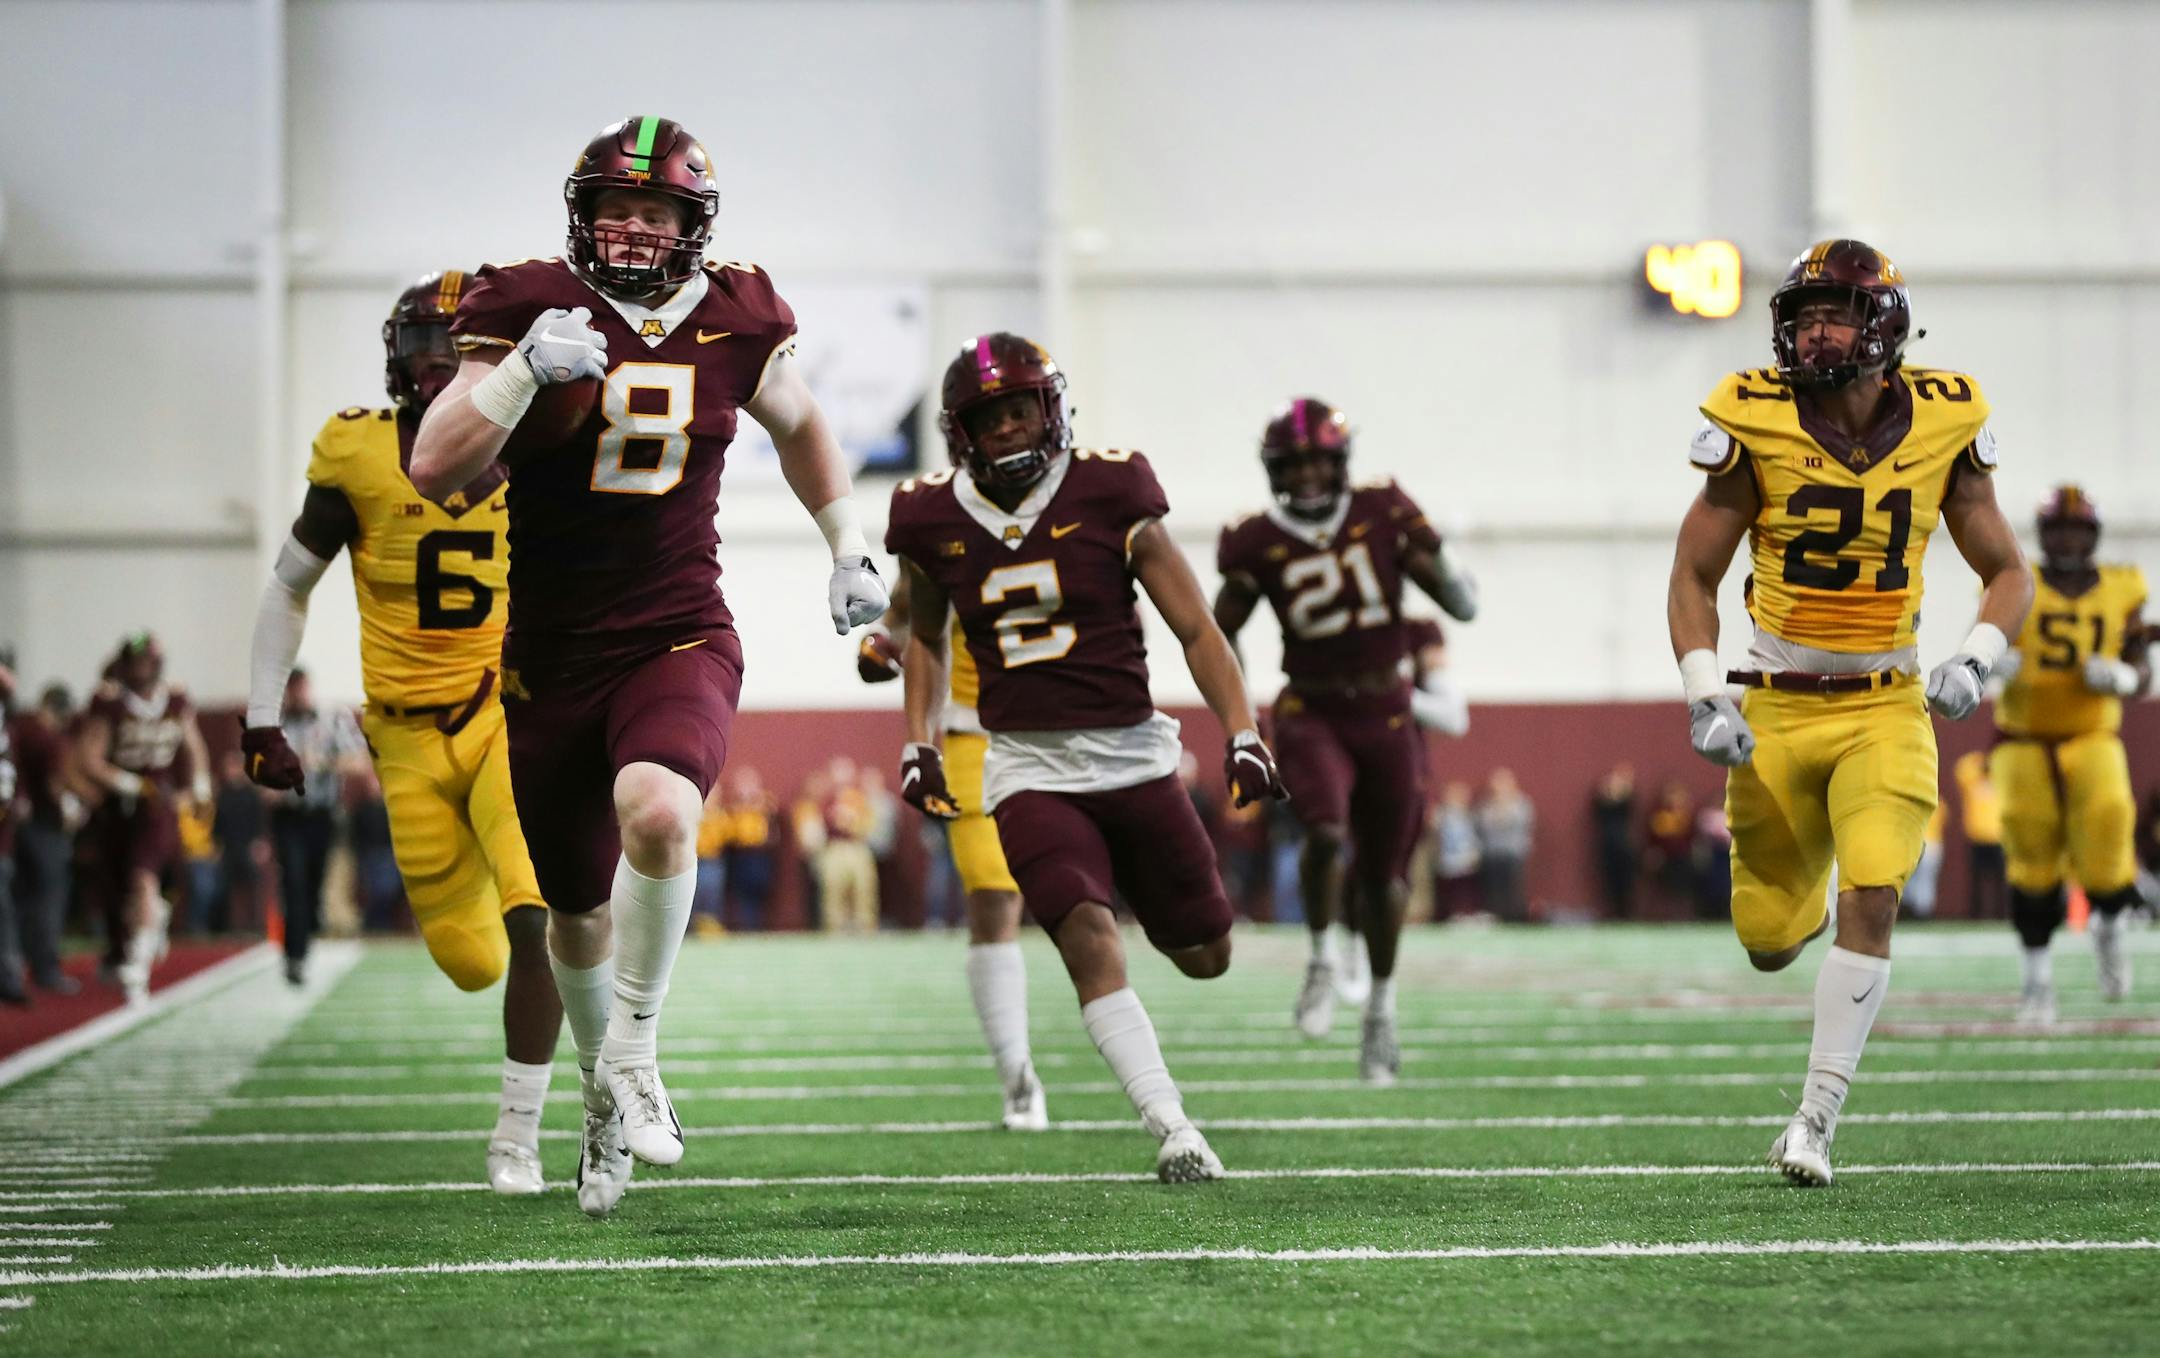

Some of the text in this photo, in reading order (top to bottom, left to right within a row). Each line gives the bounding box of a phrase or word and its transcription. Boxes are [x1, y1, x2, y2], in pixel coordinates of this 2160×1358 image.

[1646, 241, 1742, 318] 40
[590, 361, 696, 496] 8
[416, 530, 495, 629] 6
[1783, 484, 1912, 592] 21
[981, 559, 1078, 669] 2
[1282, 543, 1393, 640] 21
[2039, 612, 2105, 669] 51
